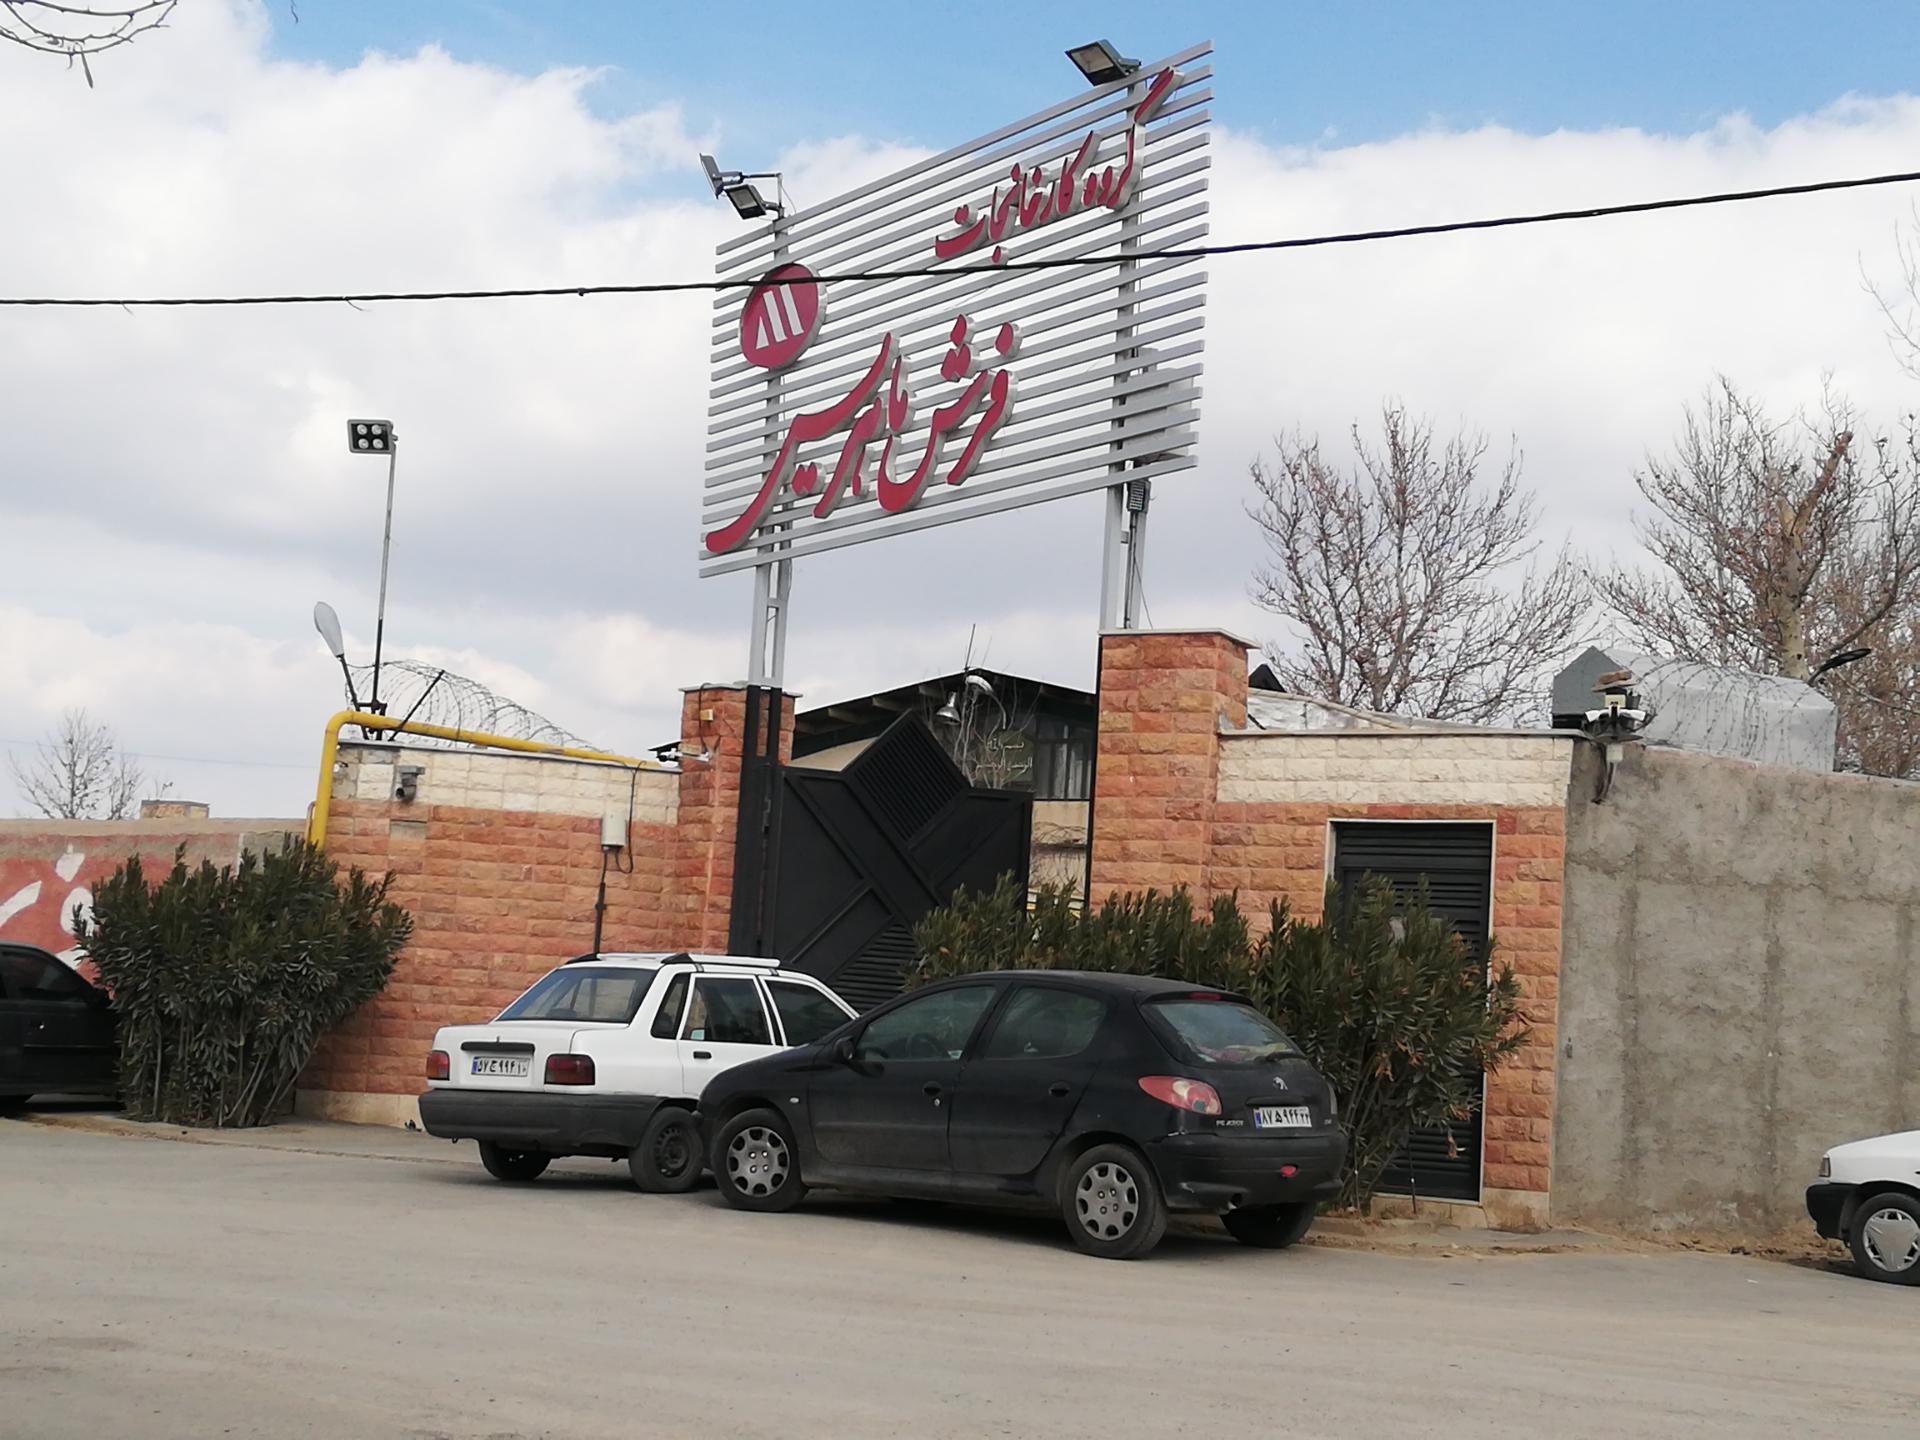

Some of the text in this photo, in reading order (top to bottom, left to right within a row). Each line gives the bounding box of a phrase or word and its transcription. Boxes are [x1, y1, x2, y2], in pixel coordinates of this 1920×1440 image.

[934, 66, 1180, 265] گروه کارخانجات
[876, 313, 1019, 514] فرش
